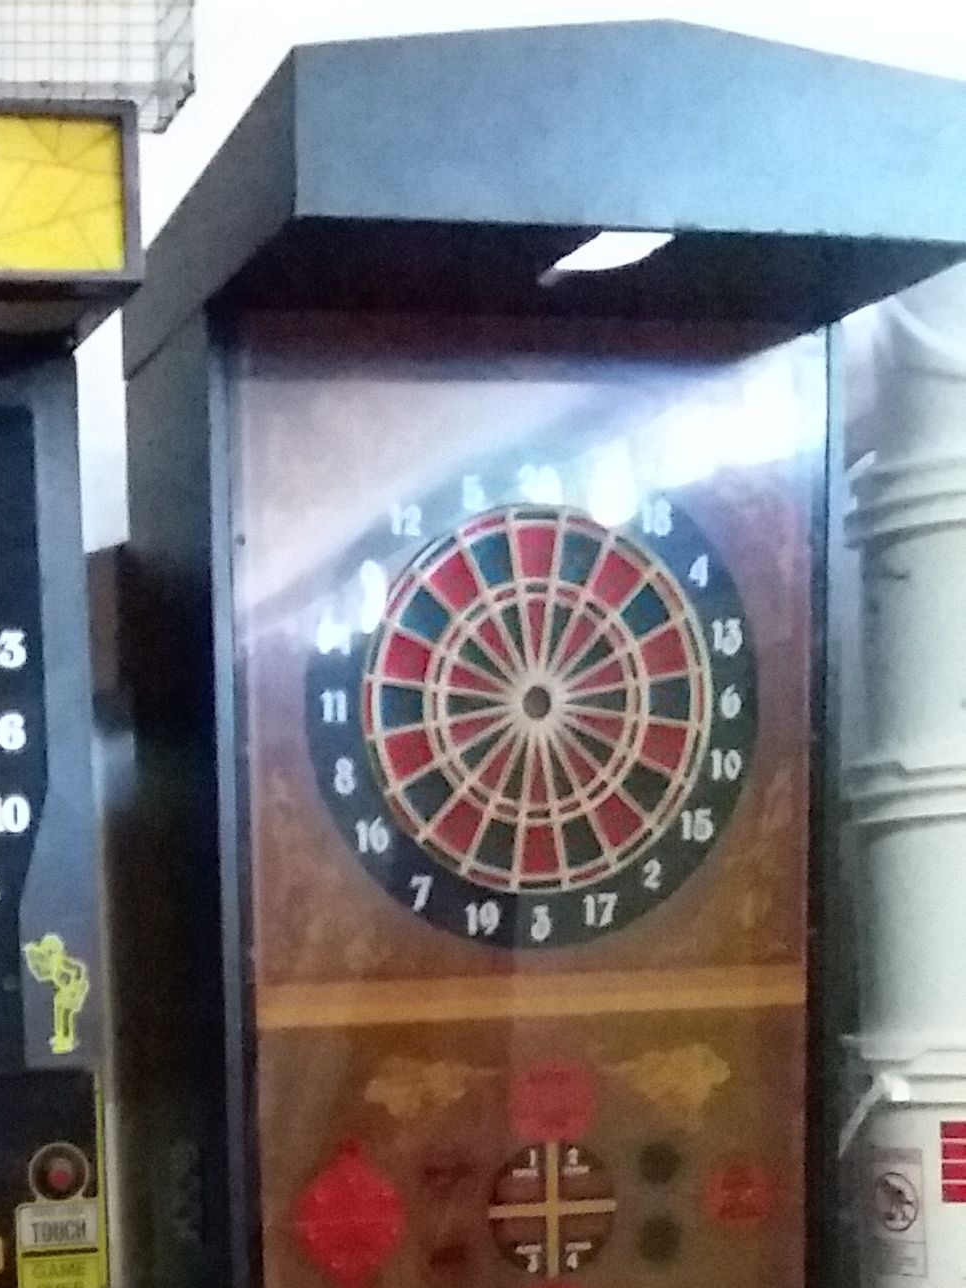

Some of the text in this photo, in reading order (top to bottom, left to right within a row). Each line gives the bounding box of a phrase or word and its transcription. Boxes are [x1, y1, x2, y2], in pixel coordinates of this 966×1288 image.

[688, 554, 710, 588] 4
[320, 689, 349, 723] 11
[720, 684, 743, 720] 6
[334, 756, 357, 796] 8
[710, 748, 743, 782] 10
[355, 816, 391, 854] 16
[680, 808, 715, 842] 15
[643, 859, 662, 890] 2
[410, 875, 432, 912] 7
[583, 892, 619, 928] 17
[465, 901, 501, 936] 19
